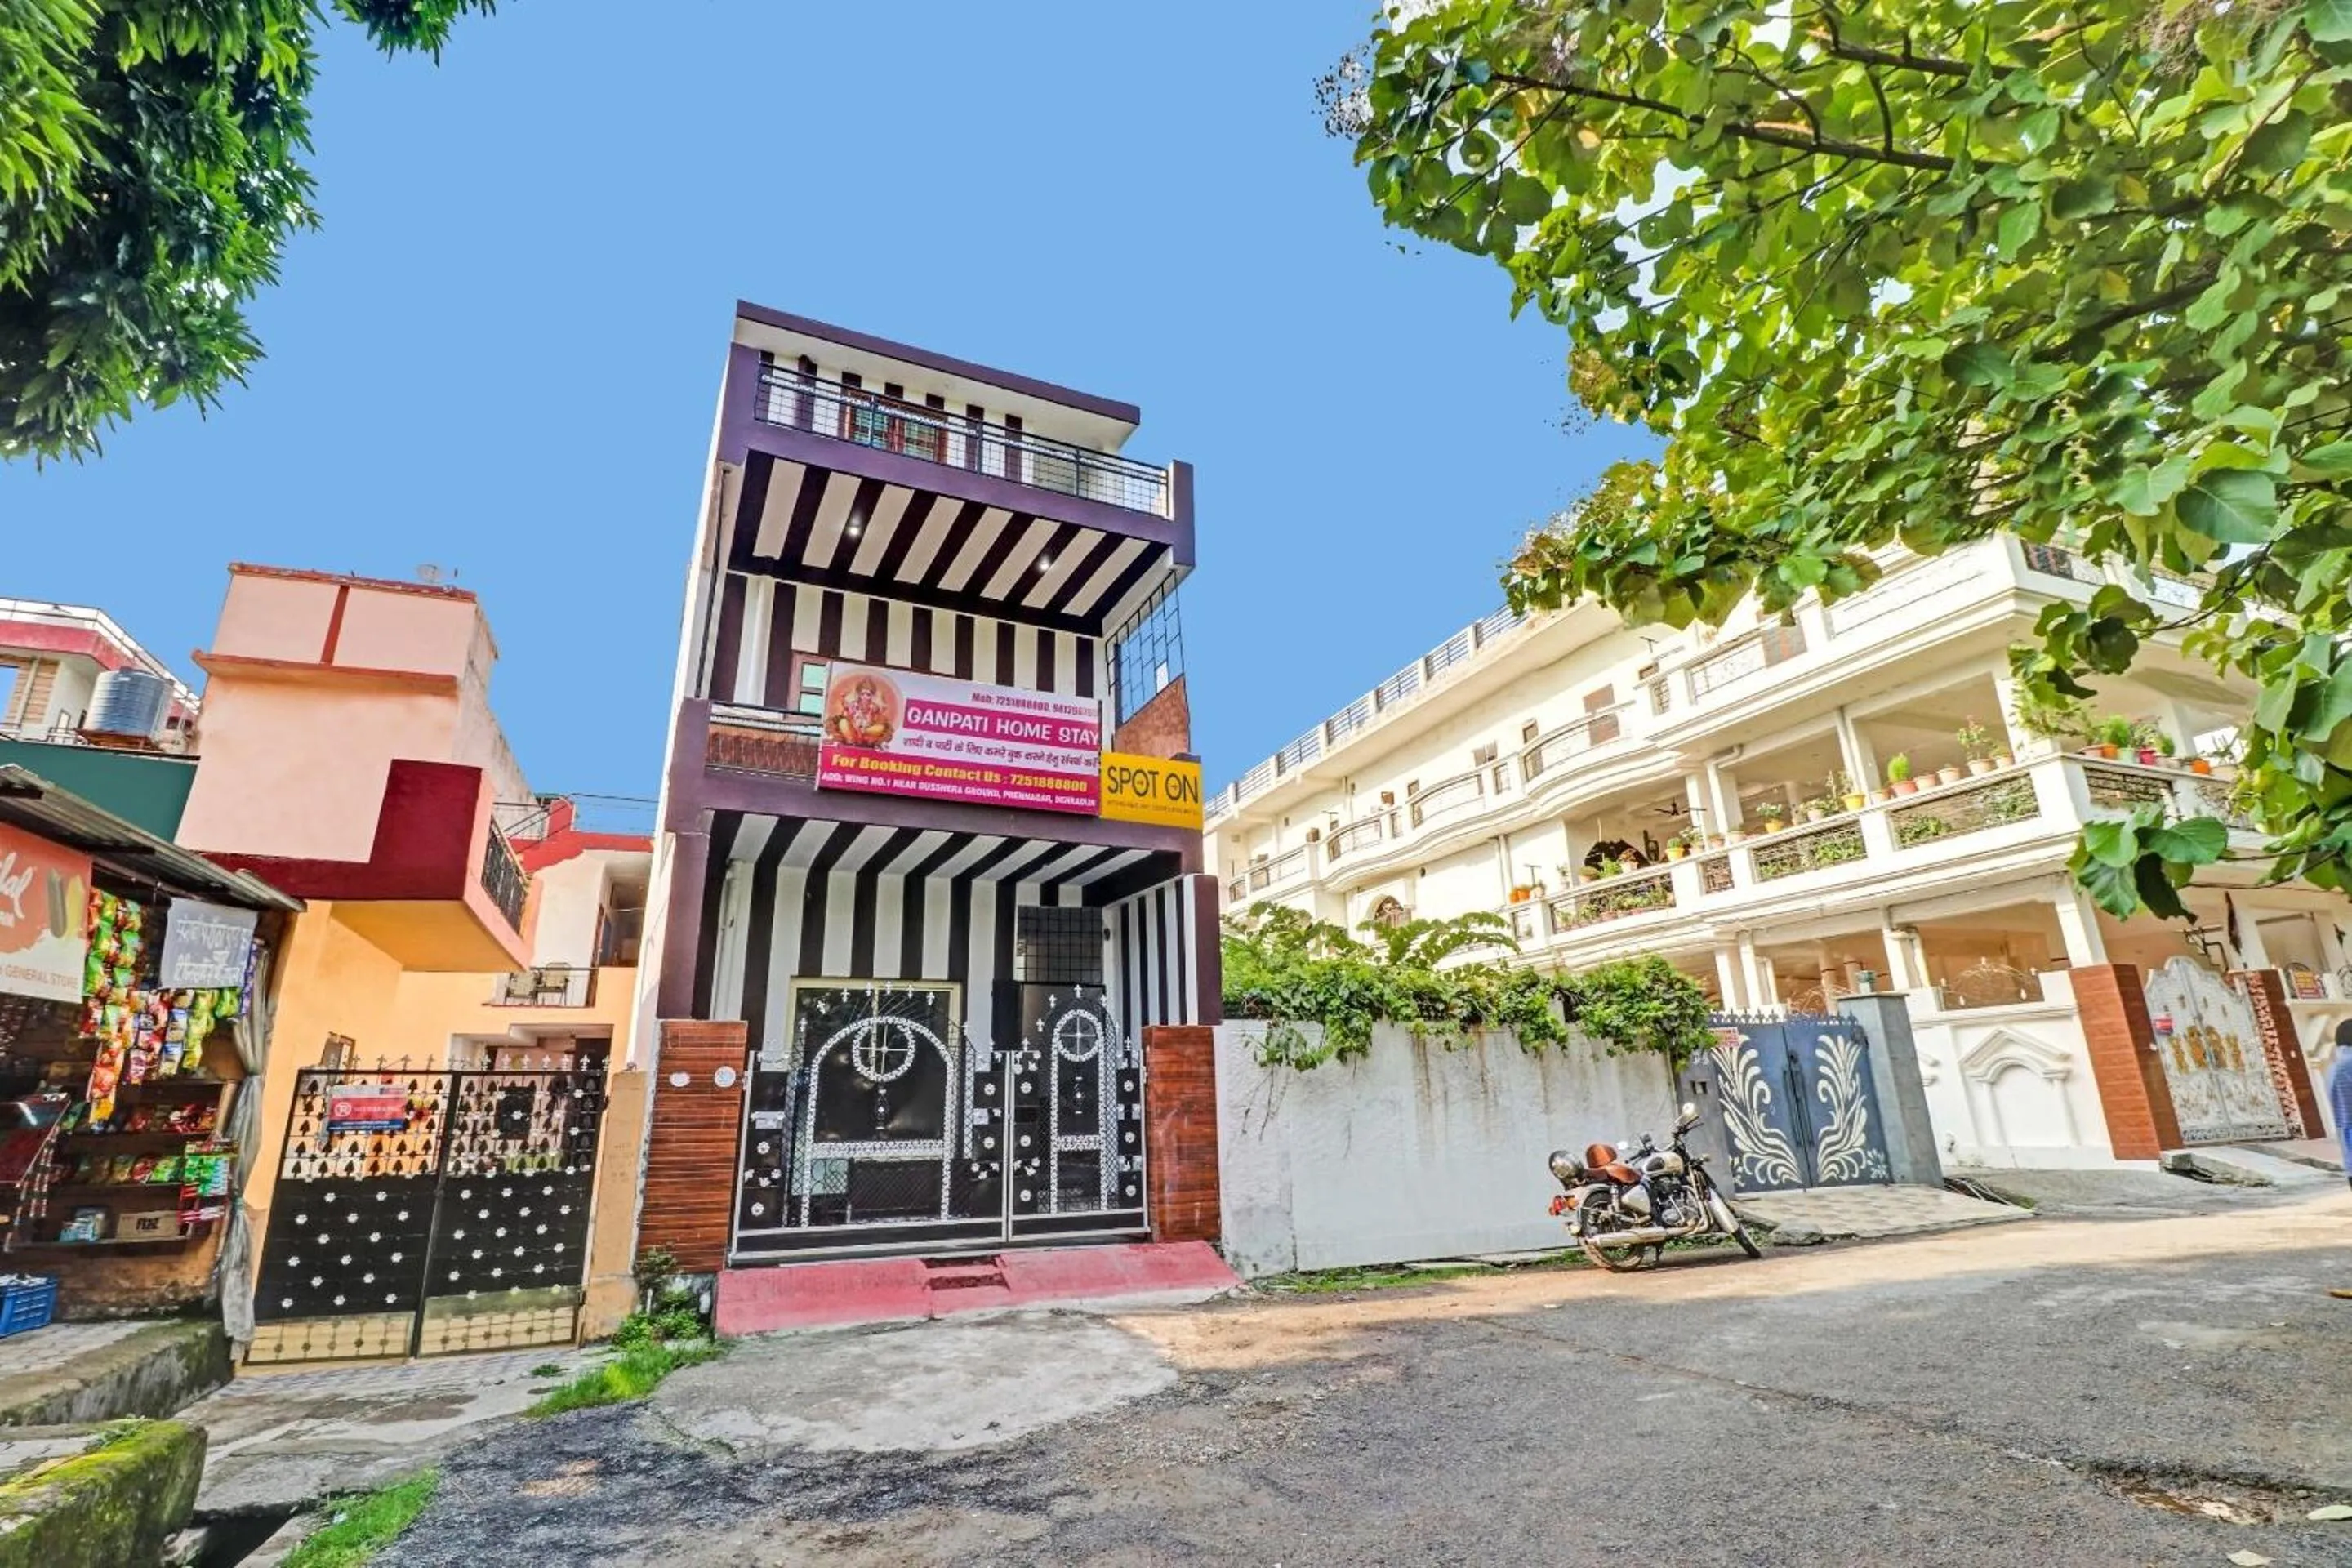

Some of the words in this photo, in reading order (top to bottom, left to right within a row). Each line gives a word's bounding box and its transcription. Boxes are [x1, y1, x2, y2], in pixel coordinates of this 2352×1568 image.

[907, 707, 988, 733] GANPATI
[996, 719, 1052, 741] HOME
[1058, 726, 1098, 746] STAY
[954, 741, 964, 752] के
[967, 741, 983, 755] लिए
[831, 754, 858, 768] For
[858, 756, 923, 776] Booking
[924, 764, 981, 782] Contact
[983, 771, 1001, 783] Us
[1107, 765, 1159, 799] SPOT
[1165, 773, 1199, 804] ON
